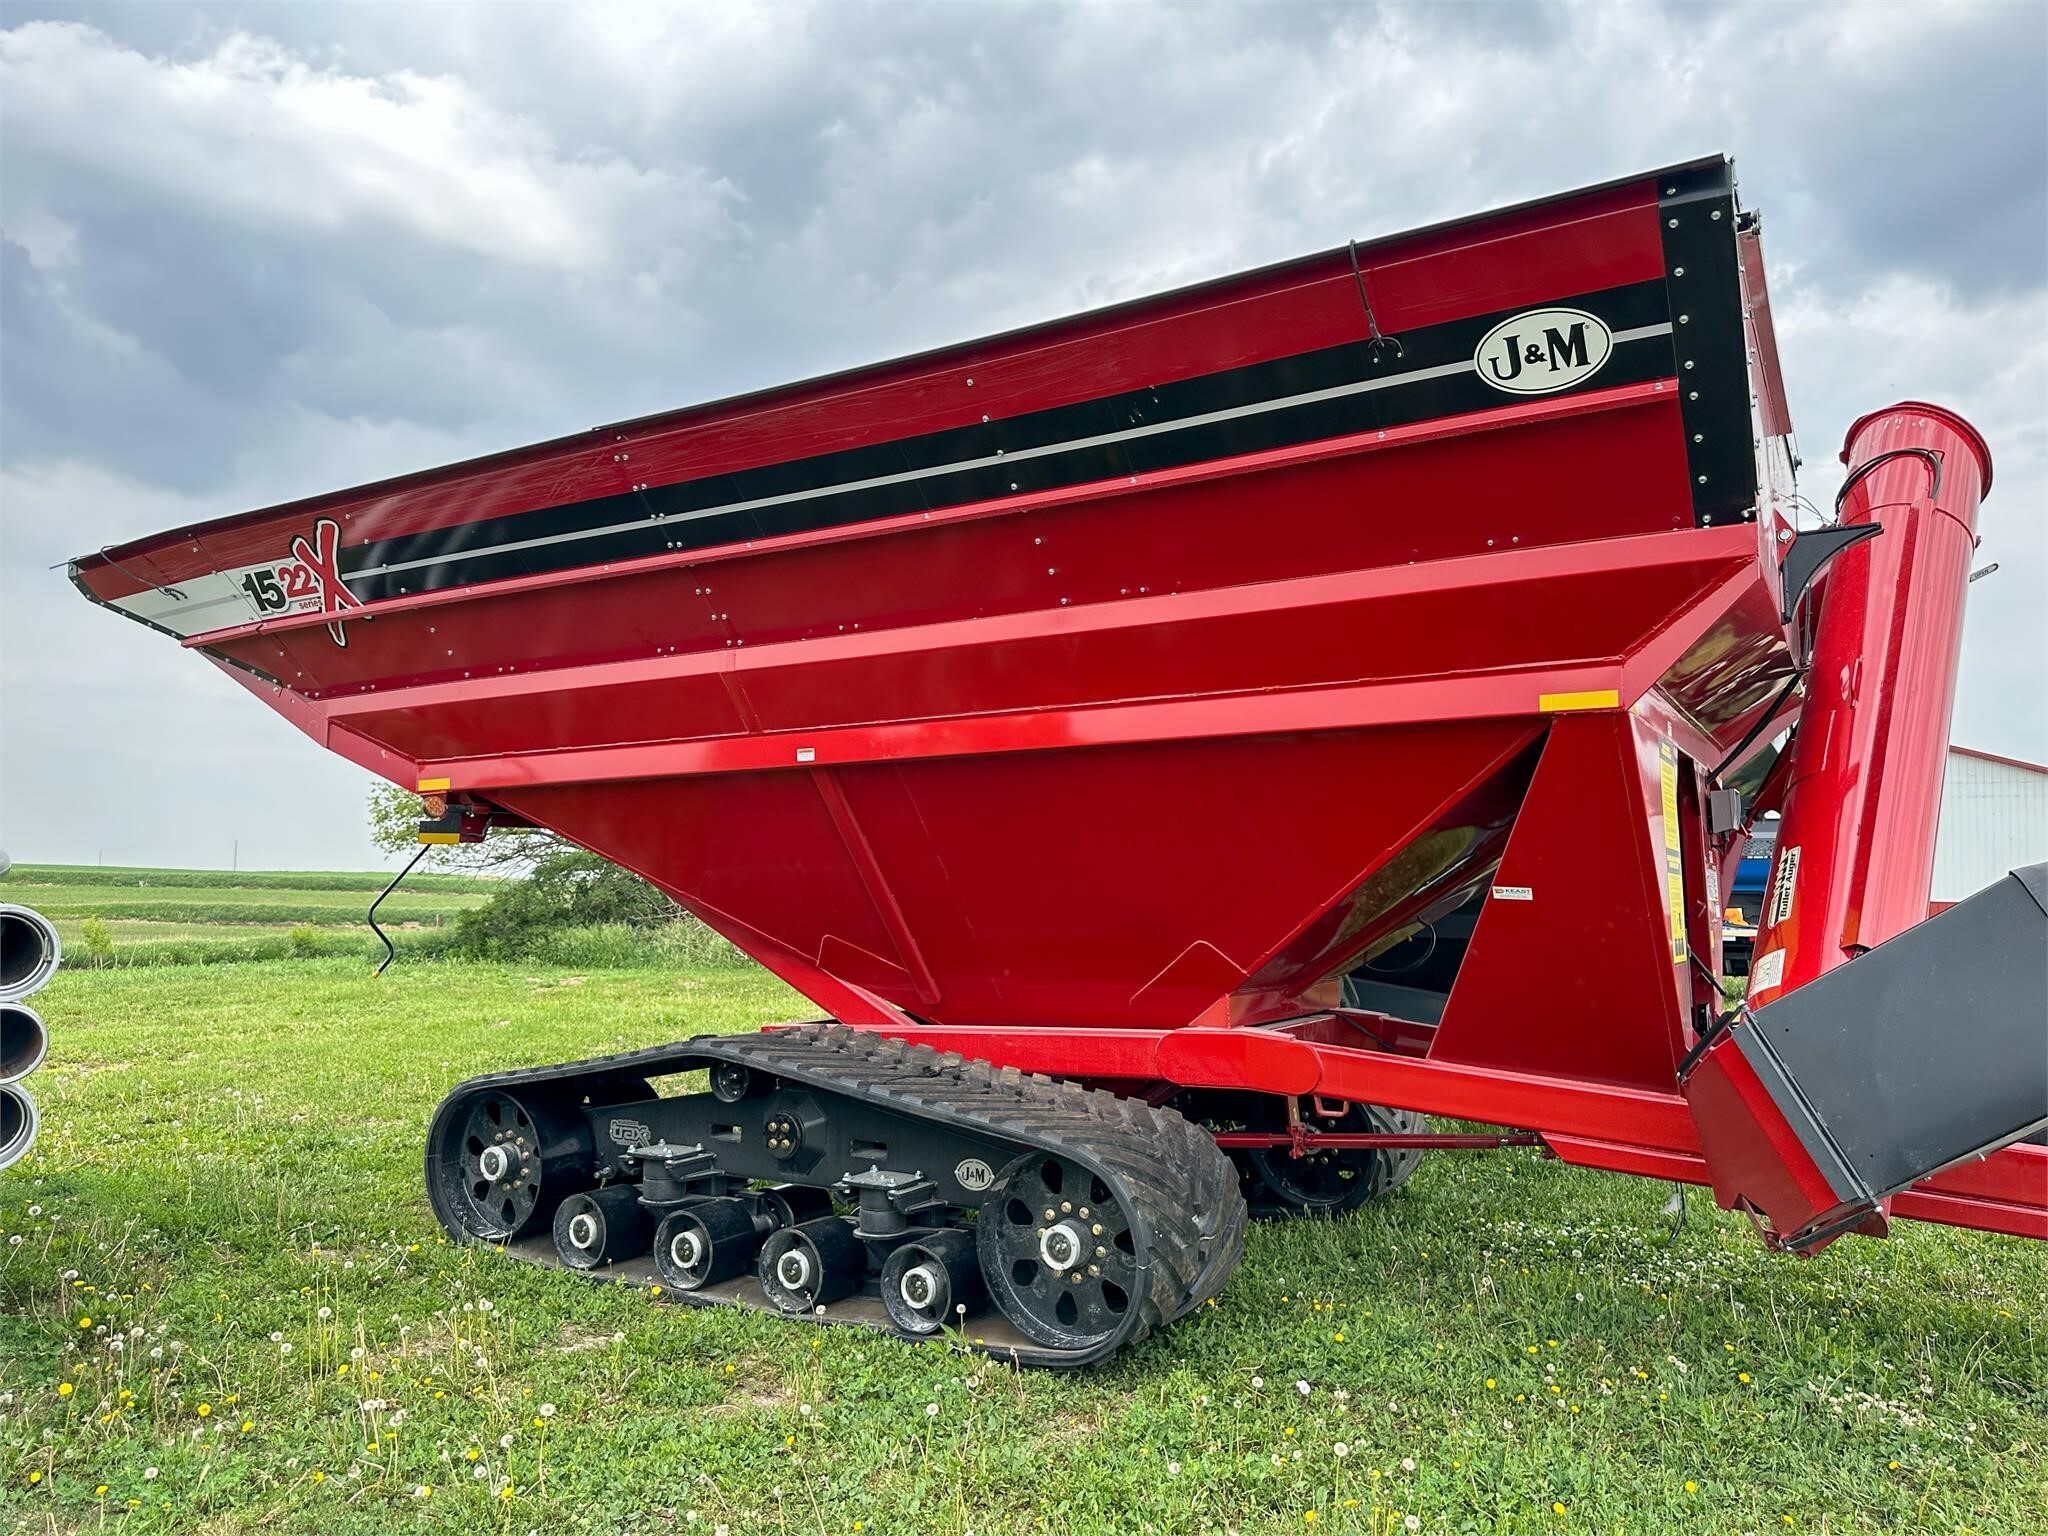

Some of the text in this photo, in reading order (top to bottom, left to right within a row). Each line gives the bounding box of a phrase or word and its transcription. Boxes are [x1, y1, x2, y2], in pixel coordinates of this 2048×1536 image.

[1488, 322, 1591, 381] J&M
[299, 599, 323, 610] series
[1780, 853, 1797, 917] Bullet Auger
[962, 1166, 985, 1183] J&M
